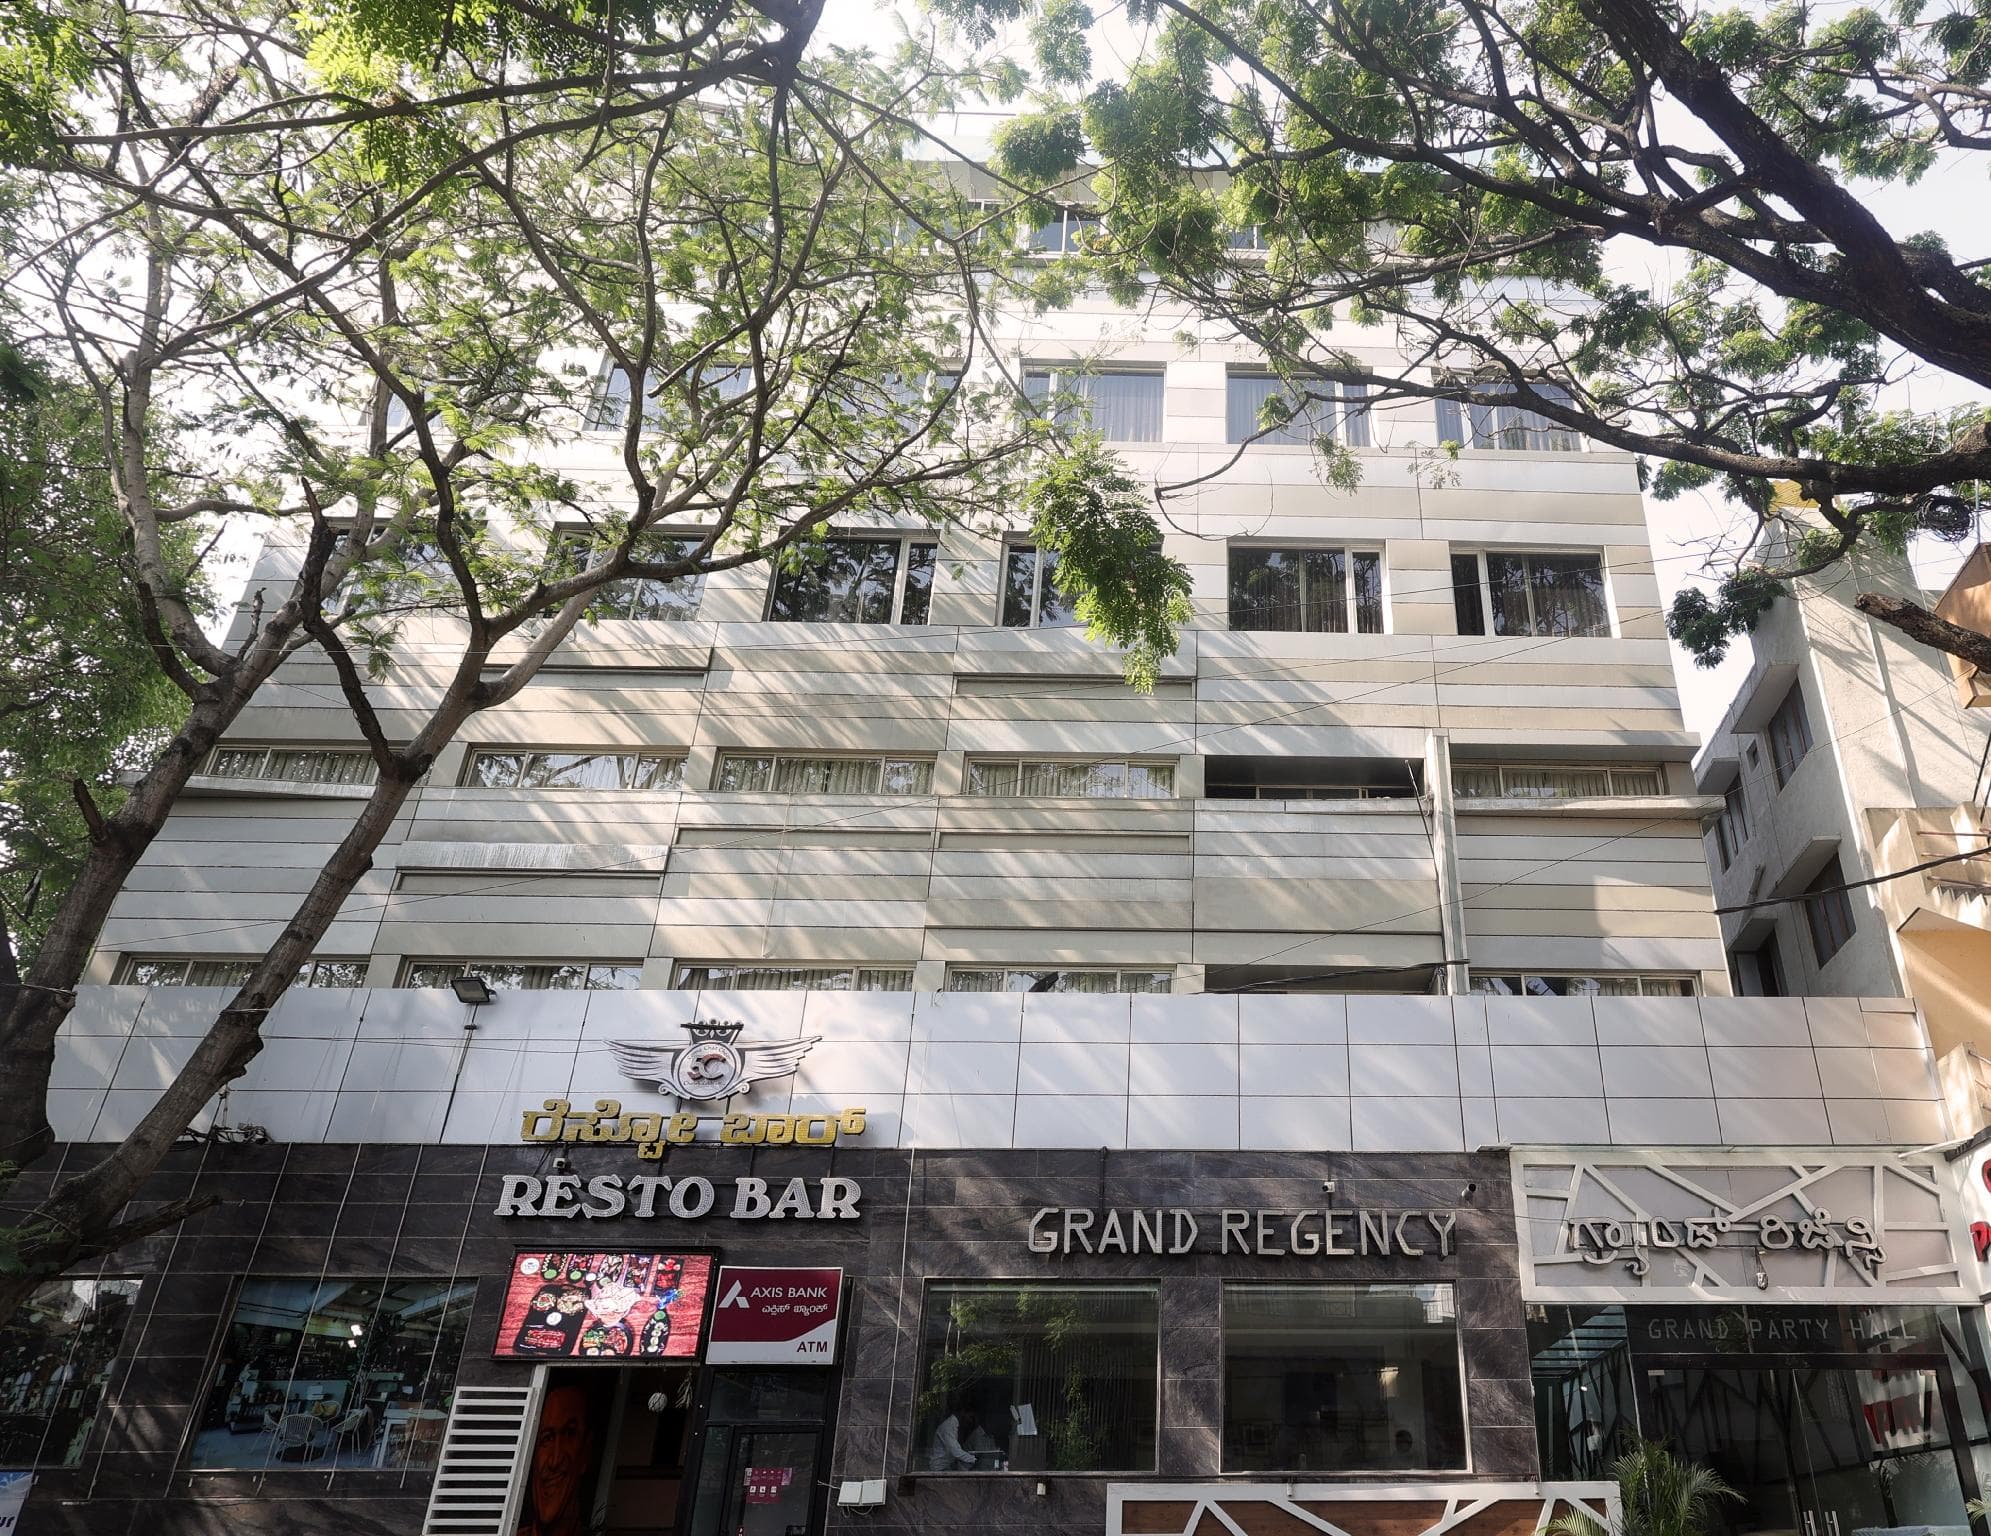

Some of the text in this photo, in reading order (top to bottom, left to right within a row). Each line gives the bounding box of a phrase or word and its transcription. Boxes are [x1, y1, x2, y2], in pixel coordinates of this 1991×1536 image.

[720, 1107, 866, 1146] ಬಾರ್
[493, 1174, 863, 1220] RESTO BAR
[1027, 1207, 1457, 1258] GRAND REGENCY
[750, 1287, 828, 1298] AXIS BANK
[1649, 1318, 1917, 1340] GRAND PARTY HALL
[796, 1341, 828, 1353] ATM
